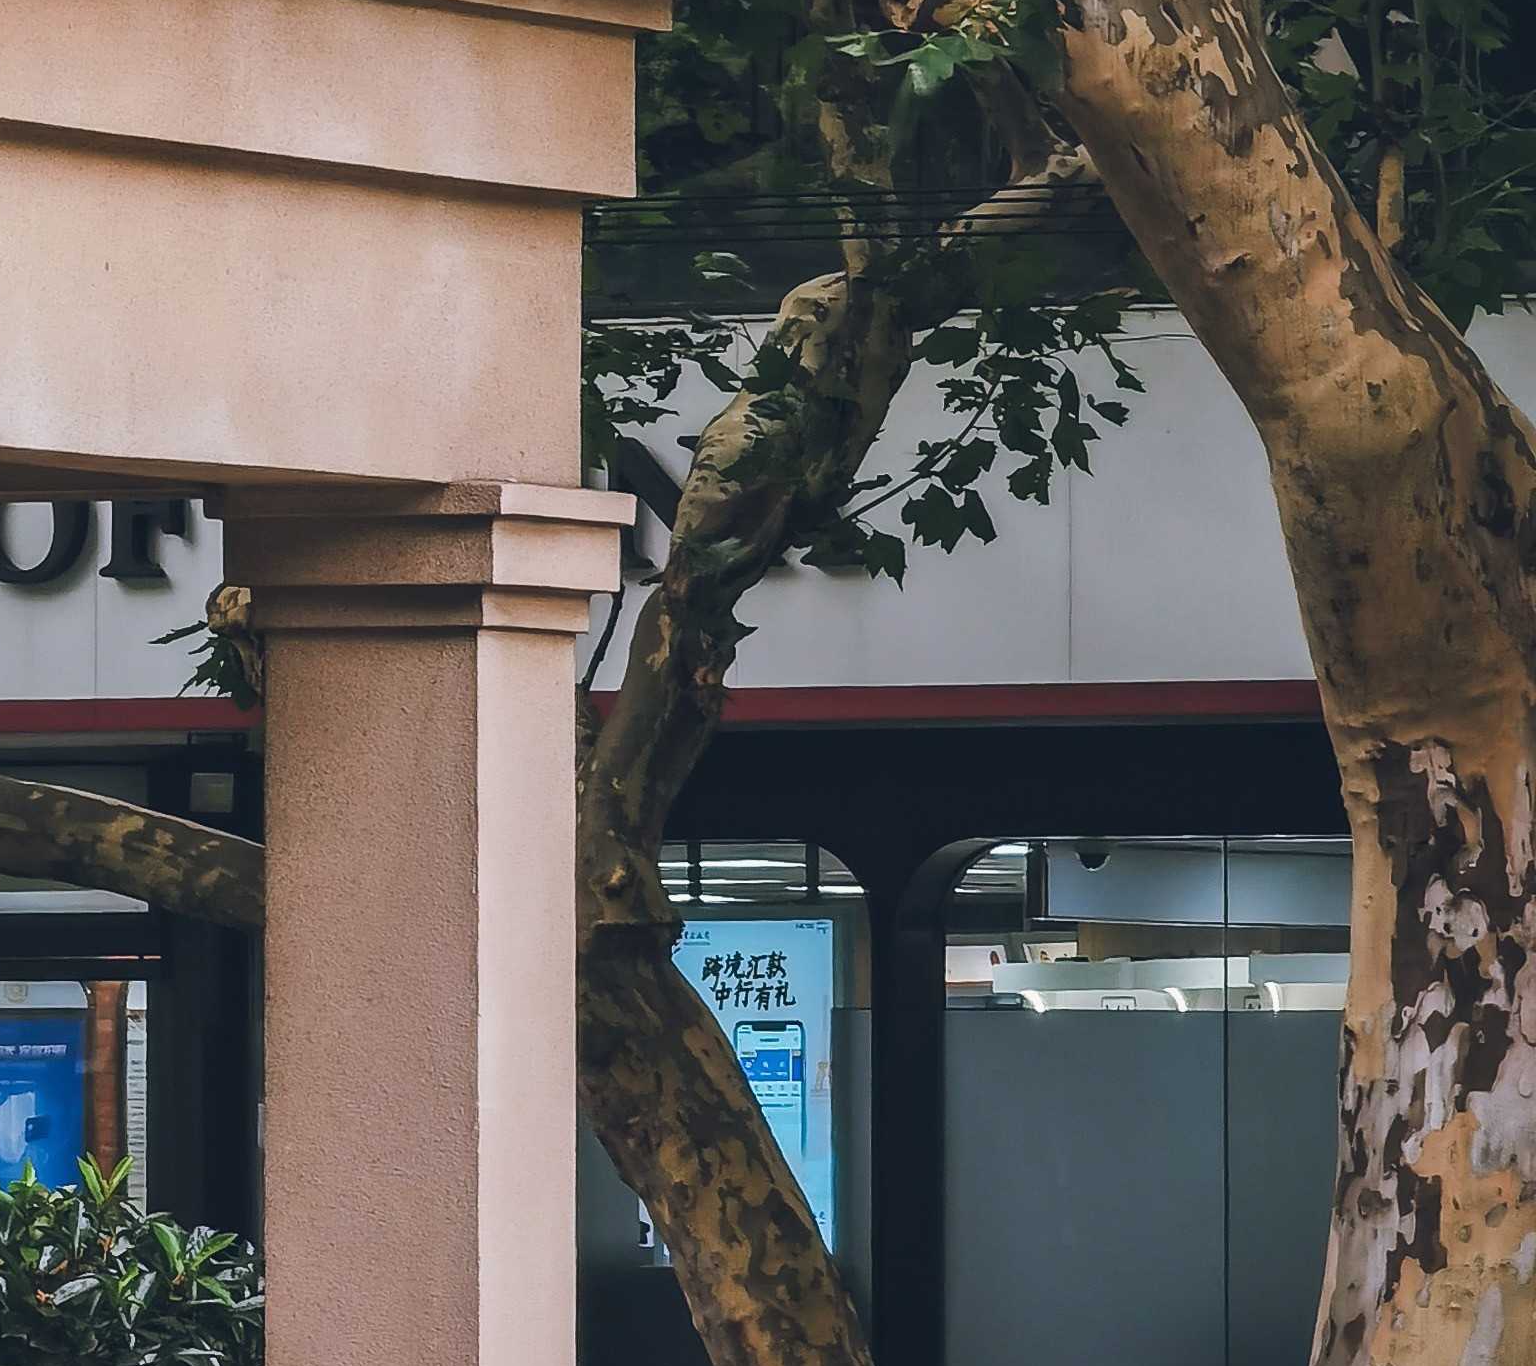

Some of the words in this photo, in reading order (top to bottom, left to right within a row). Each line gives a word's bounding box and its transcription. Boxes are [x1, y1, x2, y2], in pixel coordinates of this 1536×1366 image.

[702, 951, 788, 992] 跨境汇款
[715, 980, 796, 1011] 中行有礼
